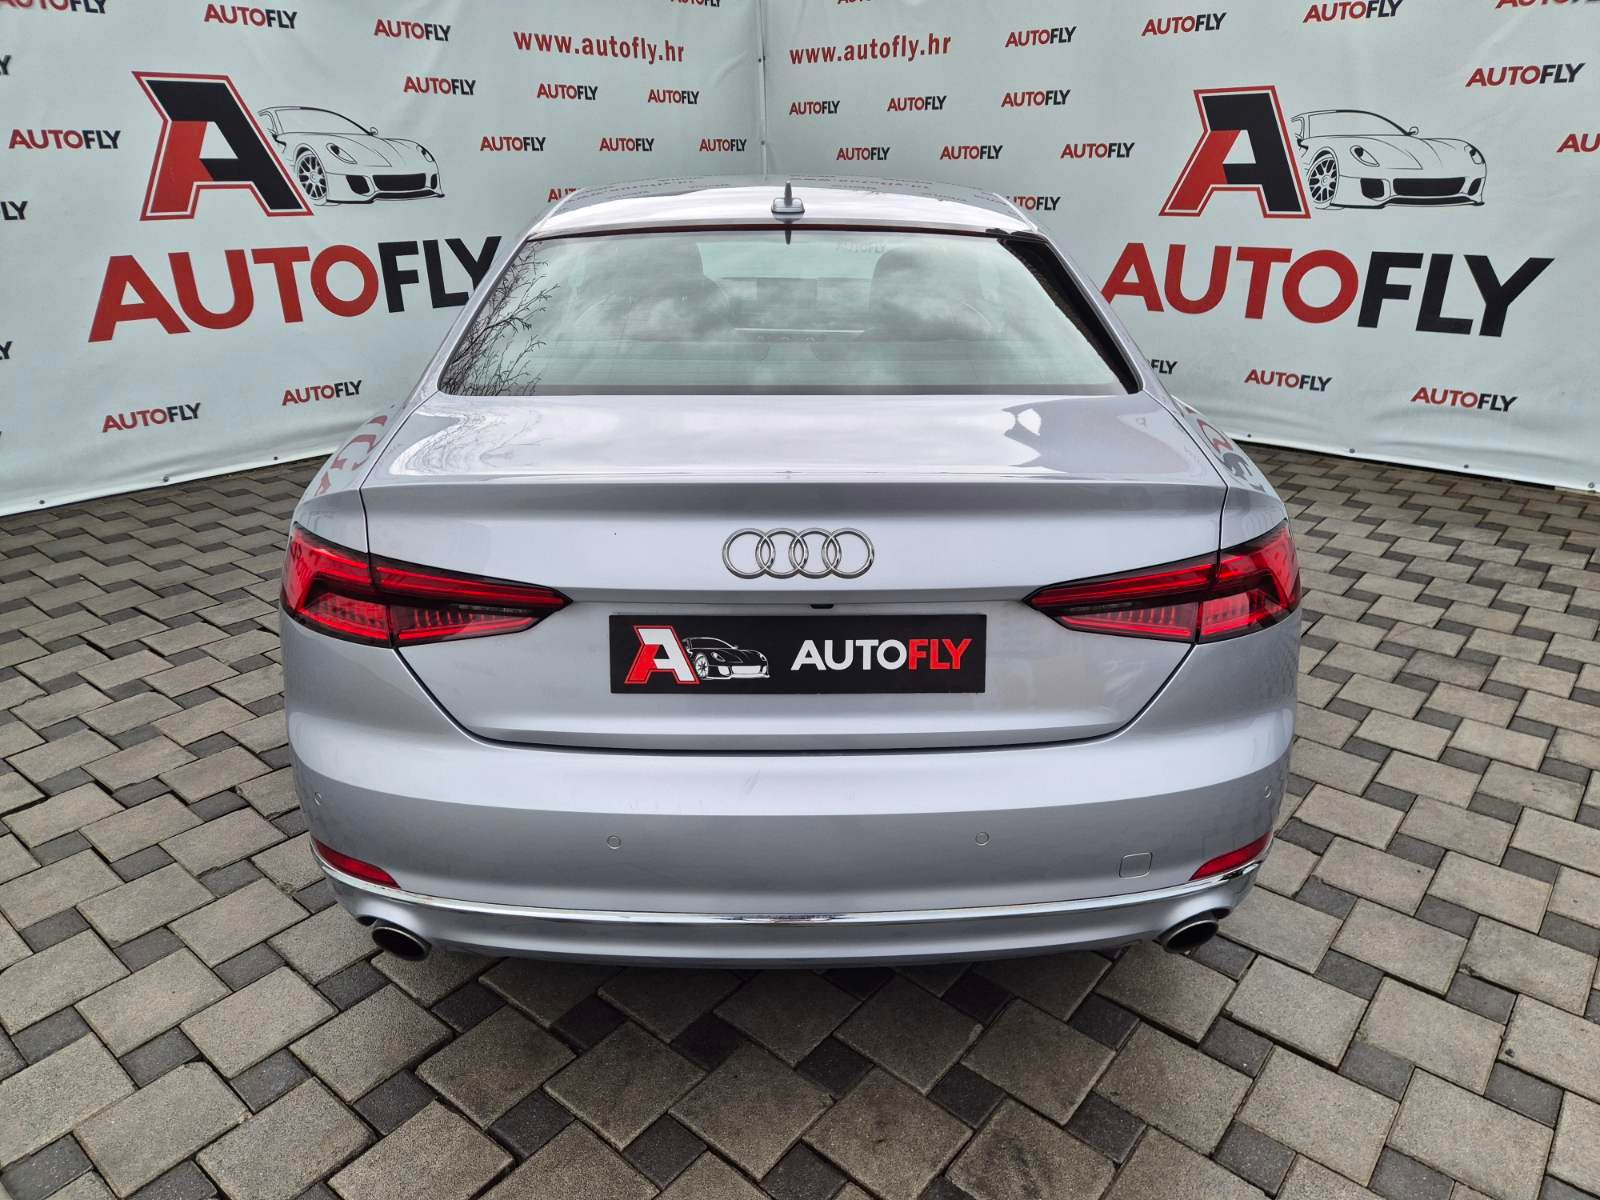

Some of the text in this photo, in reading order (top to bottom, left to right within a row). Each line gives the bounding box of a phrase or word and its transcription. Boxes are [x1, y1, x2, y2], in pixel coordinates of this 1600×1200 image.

[205, 4, 297, 29] AUTOFLY
[1303, 0, 1403, 23] AUTOFLY
[374, 19, 450, 41] AUTOFLY
[1141, 12, 1227, 36] AUTOFLY
[1005, 26, 1077, 47] AUTOFLY
[513, 31, 684, 64] www.autofly.hr
[790, 33, 951, 64] www.autofly.hr
[1465, 63, 1585, 87] AUTOFLY
[404, 77, 476, 95] AUTOFLY
[537, 83, 598, 100] AUTOFLY
[648, 89, 699, 104] AUTOFLY
[789, 101, 840, 115] AUTOFLY
[887, 96, 946, 112] AUTOFLY
[1001, 89, 1070, 108] AUTOFLY
[9, 129, 121, 149] AUTOFLY
[480, 136, 546, 151] AUTOFLY
[600, 138, 654, 152] AUTOFLY
[700, 139, 747, 151] AUTOFLY
[836, 147, 890, 160] AUTOFLY
[940, 145, 1003, 160] AUTOFLY
[1061, 143, 1135, 159] AUTOFLY
[1101, 243, 1555, 338] AUTOFLY
[1244, 369, 1332, 392] AUTOFLY
[282, 380, 362, 406] AUTOFLY
[1411, 387, 1517, 413] AUTOFLY
[103, 403, 200, 433] AUTOFLY
[790, 638, 973, 671] AUTOFLY
